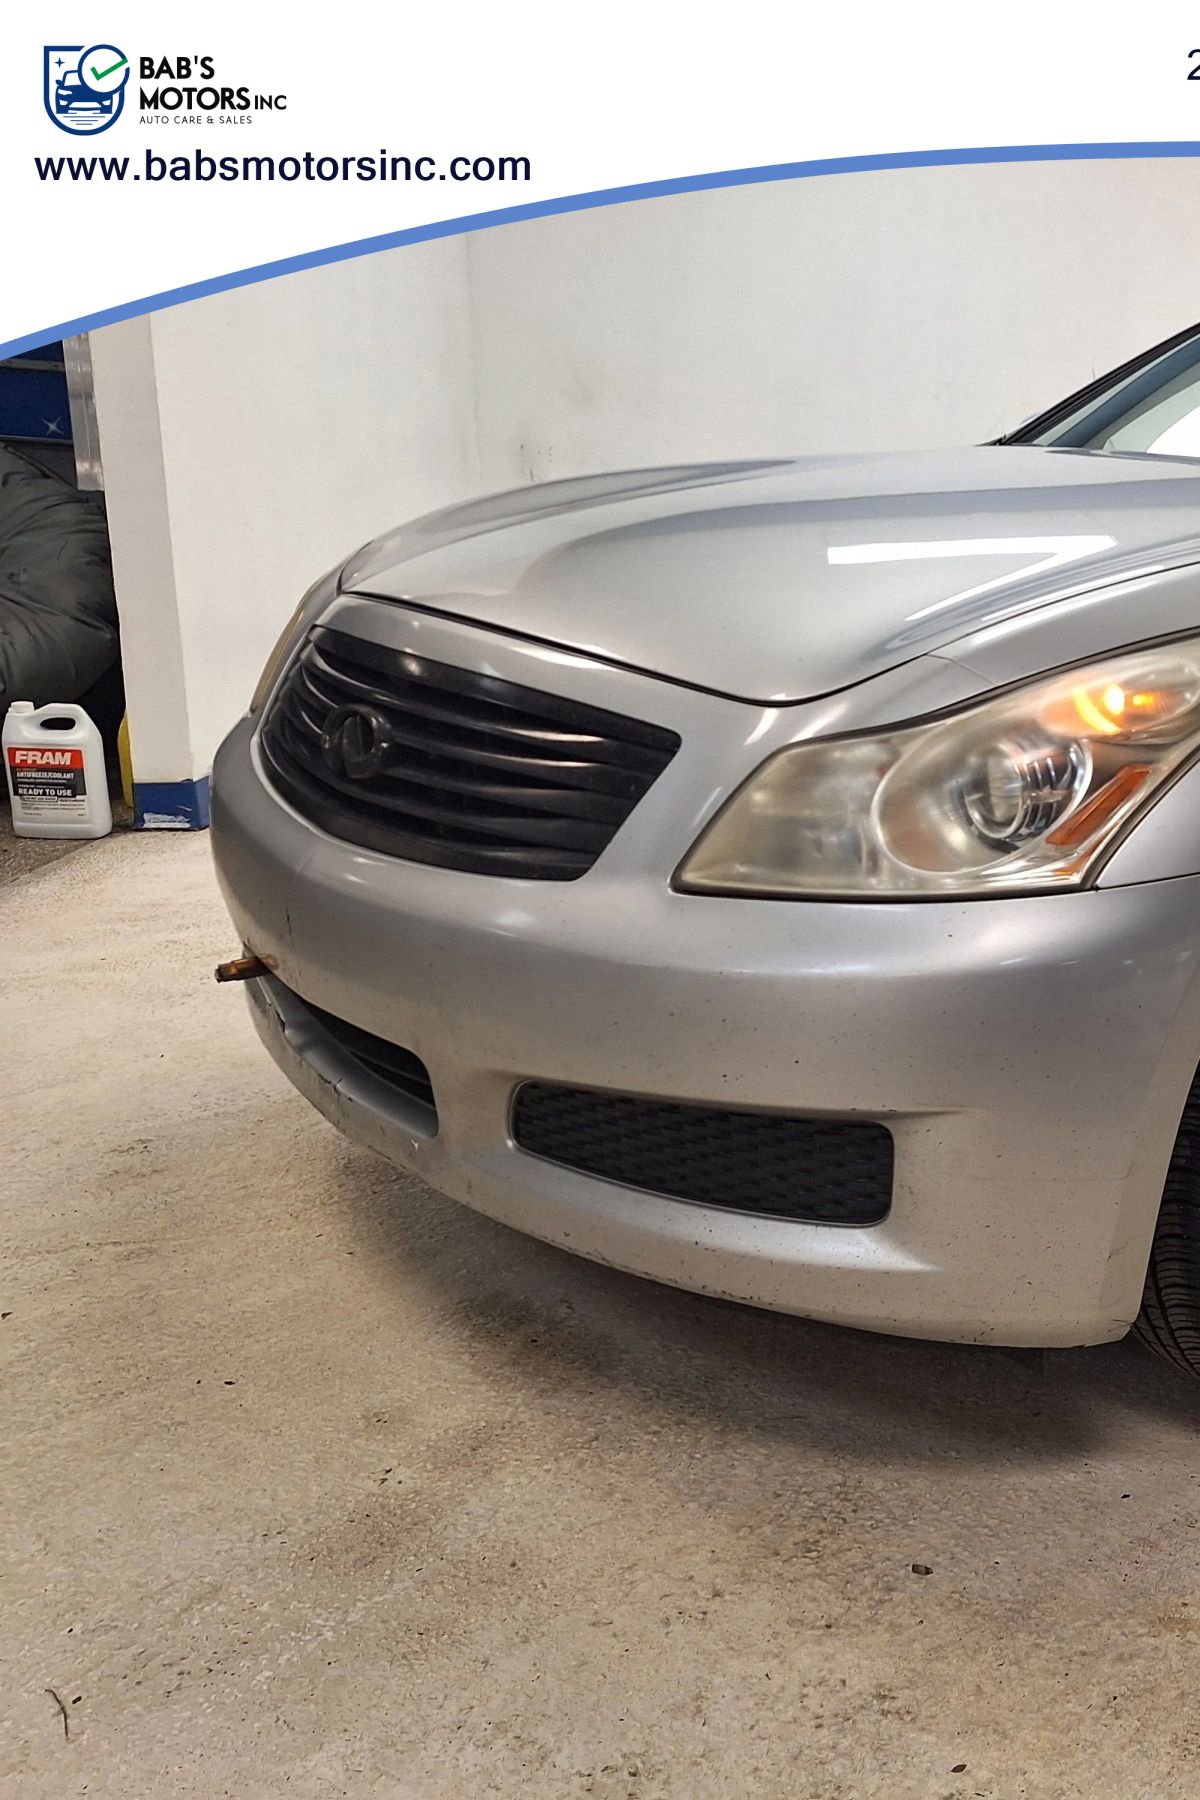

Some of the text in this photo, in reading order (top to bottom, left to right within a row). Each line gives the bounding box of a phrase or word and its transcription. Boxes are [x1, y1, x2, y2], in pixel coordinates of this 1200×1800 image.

[15, 750, 72, 765] FRAM
[18, 788, 72, 797] READY TO USE
